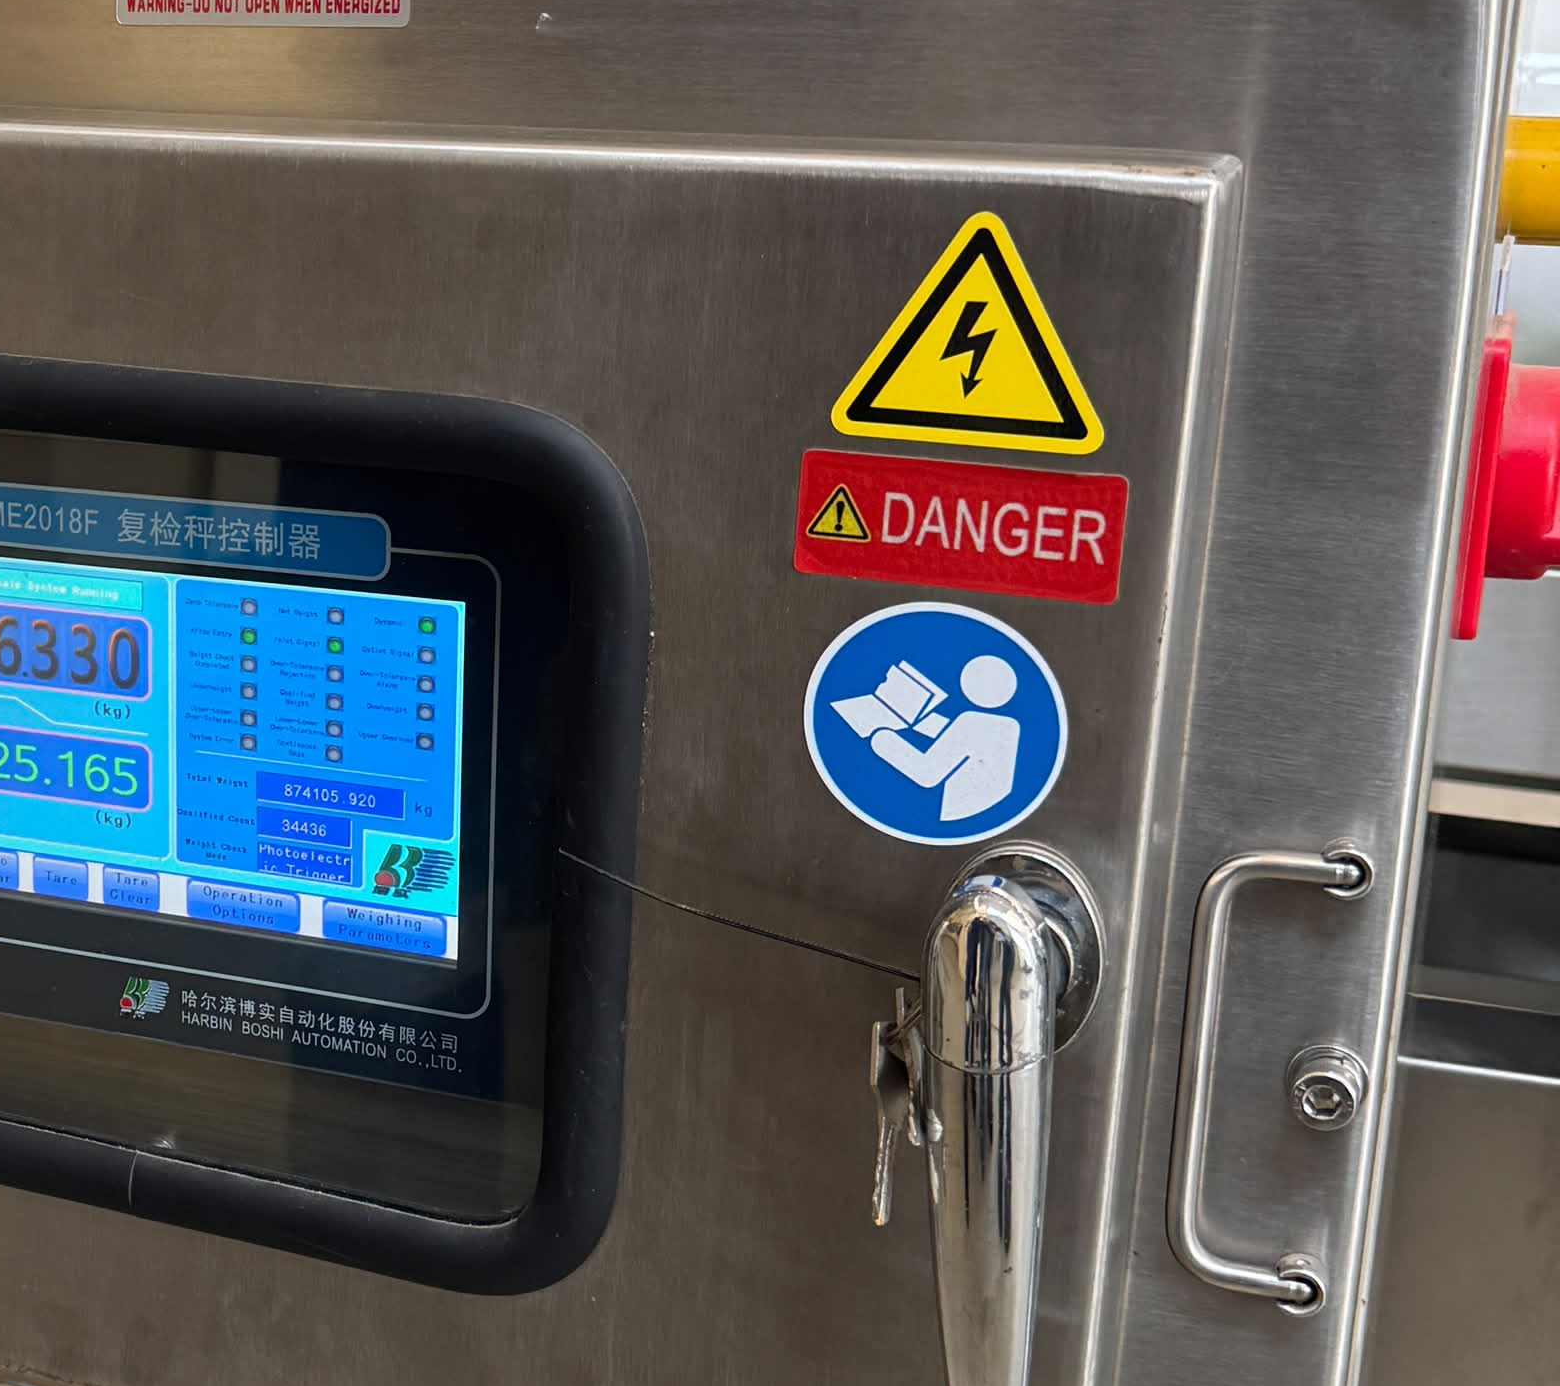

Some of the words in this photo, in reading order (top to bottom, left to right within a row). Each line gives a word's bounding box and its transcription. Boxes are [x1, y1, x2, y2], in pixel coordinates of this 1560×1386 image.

[116, 508, 321, 560] 复检秤控制器
[880, 491, 1107, 566] DANGER
[94, 701, 131, 720] (kg)
[186, 772, 212, 783] Total
[216, 776, 248, 789] Weight
[283, 783, 376, 809] 874105.920
[414, 802, 433, 817] kg
[95, 810, 133, 829] (kg)
[228, 815, 256, 826] Count
[281, 819, 327, 837] 34436
[258, 843, 351, 866] Photoelectr
[45, 869, 77, 885] Tare
[116, 872, 149, 887] Tare
[110, 889, 152, 905] Clear
[203, 885, 283, 908] Operation
[212, 904, 274, 925] Options
[346, 907, 422, 932] Weighing
[338, 924, 431, 950] Parameters
[181, 989, 459, 1054] 哈尔滨博实自动化股份有限公司
[181, 1011, 233, 1032] HARBIN
[241, 1021, 284, 1041] BOSHI
[291, 1028, 386, 1059] AUTOMATION
